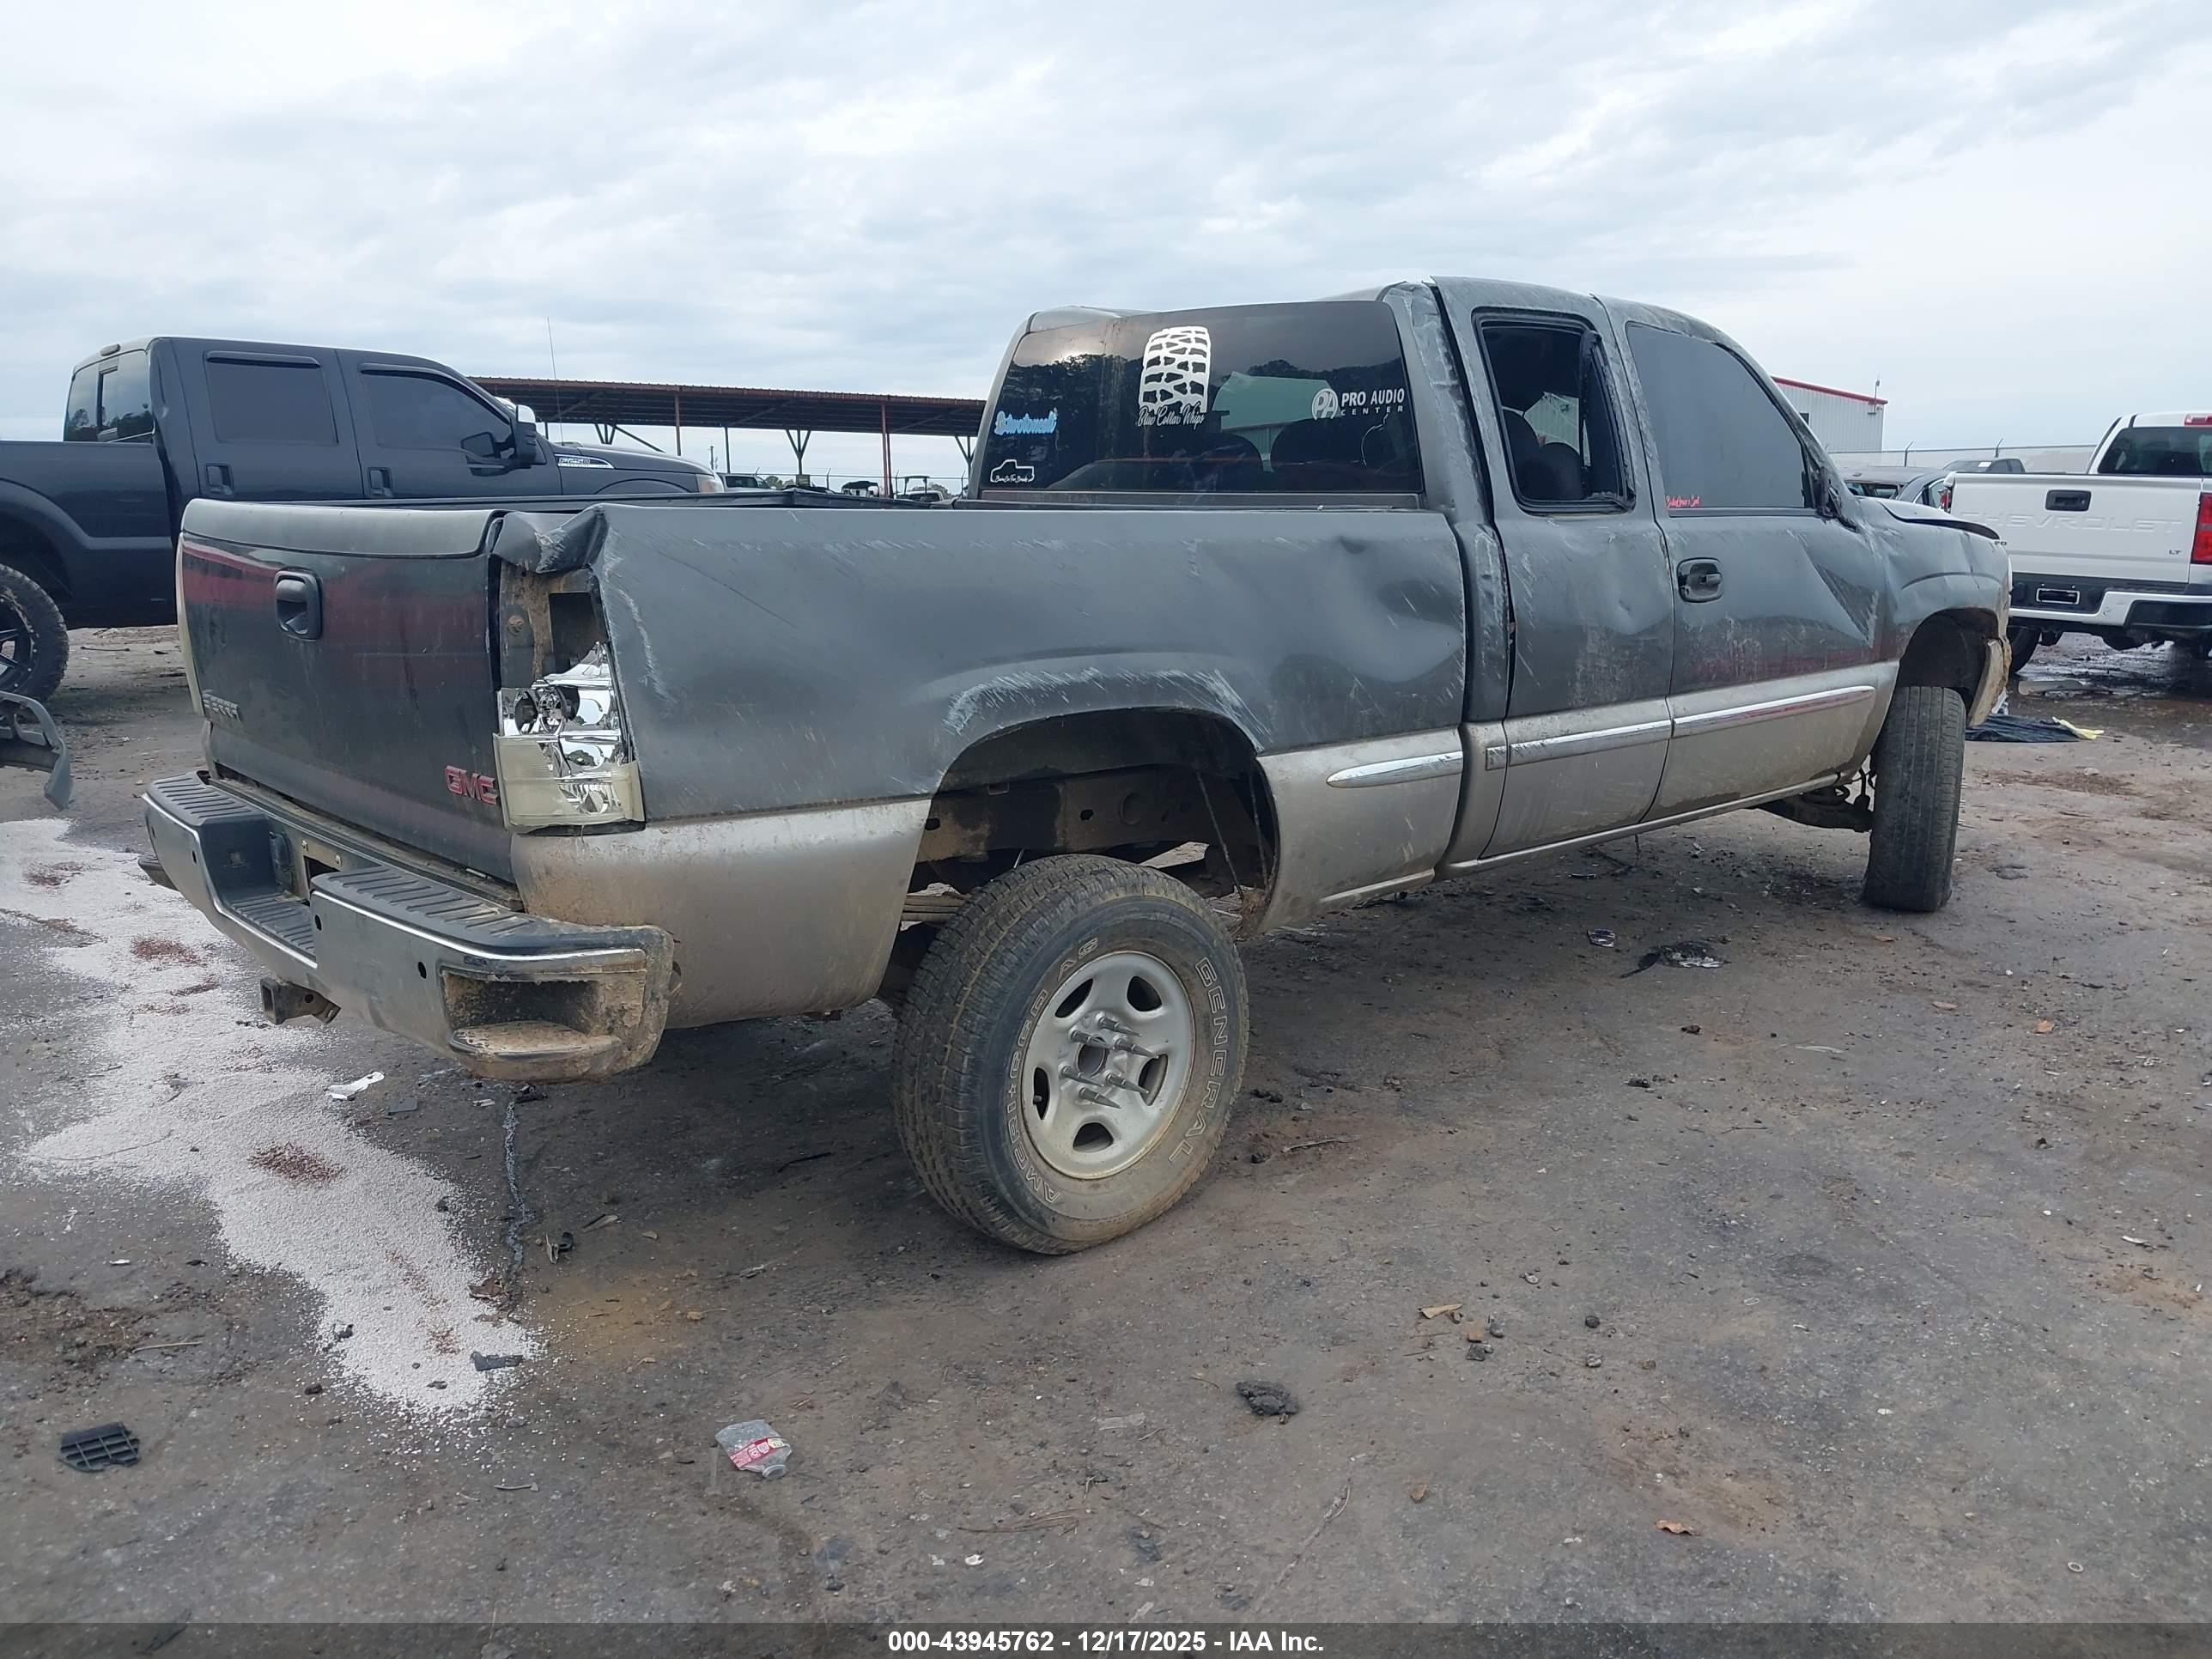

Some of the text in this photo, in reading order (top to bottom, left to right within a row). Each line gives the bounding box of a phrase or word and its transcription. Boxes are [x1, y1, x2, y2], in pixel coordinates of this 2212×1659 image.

[1340, 405, 1404, 416] CENTER
[1341, 388, 1405, 407] PRO AUDIO
[1157, 404, 1182, 426] Collar
[1183, 401, 1205, 430] Whips
[444, 765, 498, 805] GMC
[1168, 957, 1228, 1162] GENERAL
